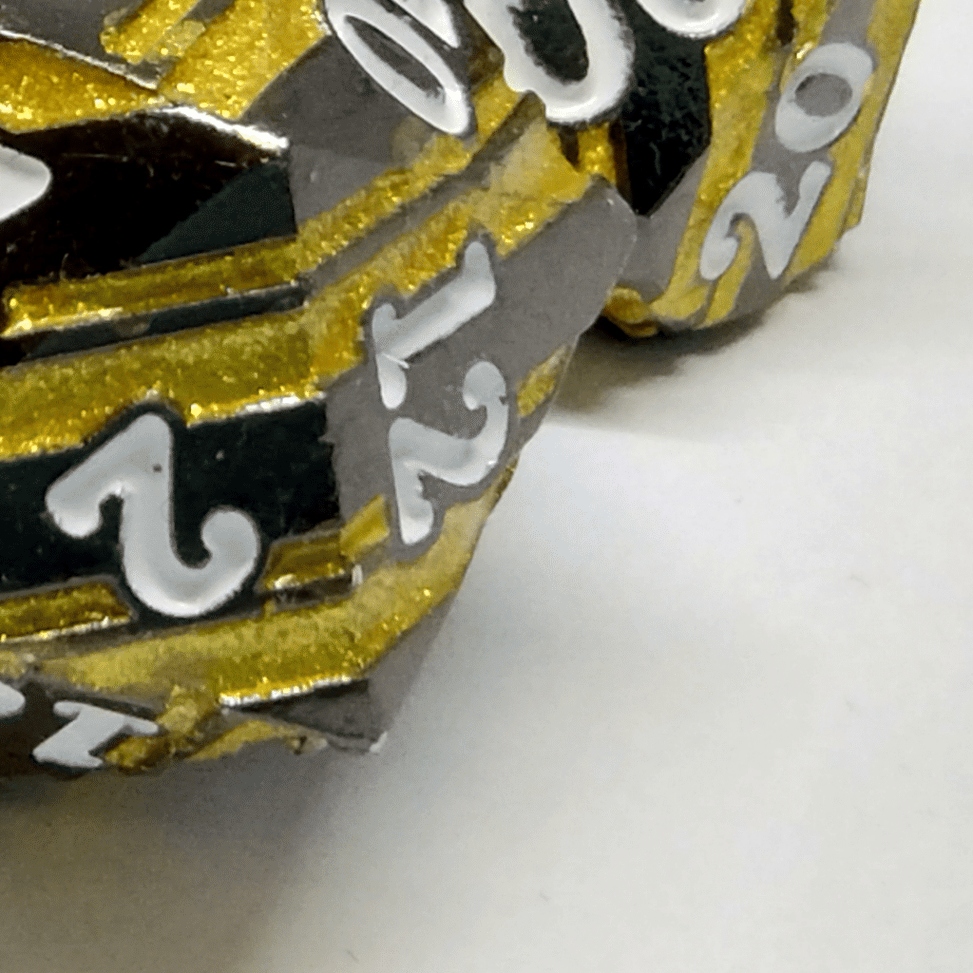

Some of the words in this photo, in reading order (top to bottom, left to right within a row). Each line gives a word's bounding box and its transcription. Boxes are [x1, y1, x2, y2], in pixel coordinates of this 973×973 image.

[699, 41, 874, 280] 20
[372, 240, 510, 545] 12
[46, 414, 262, 617] 2
